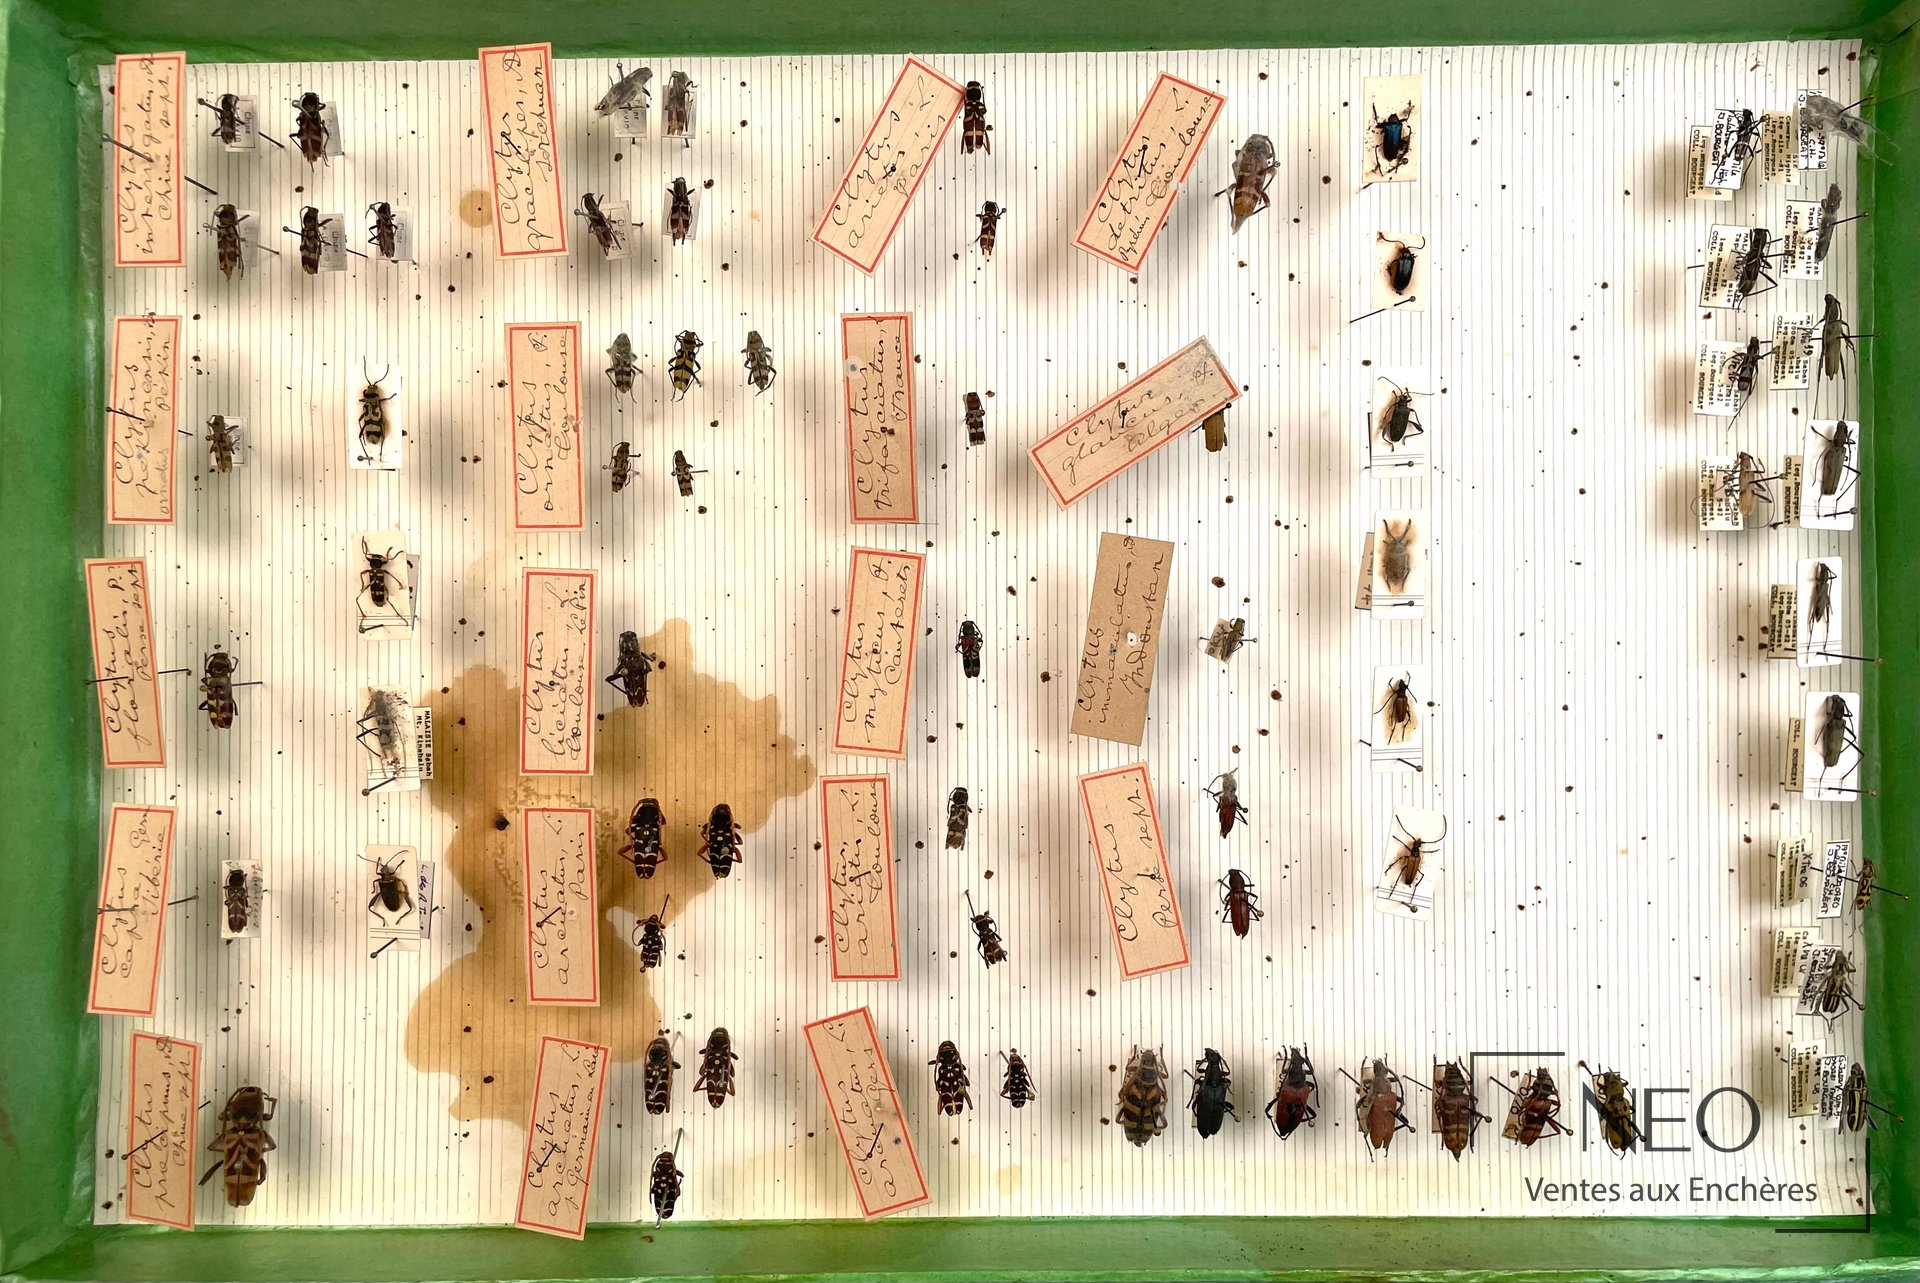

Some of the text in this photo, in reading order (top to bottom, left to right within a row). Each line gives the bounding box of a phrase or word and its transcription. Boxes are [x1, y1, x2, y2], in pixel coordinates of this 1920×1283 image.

[118, 123, 142, 232] Clytus
[156, 147, 172, 220] Chine
[488, 111, 527, 225] Clytus
[824, 105, 901, 227] Clytus
[892, 114, 950, 198] Paris
[1088, 129, 1151, 228] Clytus
[1145, 88, 1218, 208] Toulouse
[1688, 129, 1700, 194] COLL. BOURGEAT
[1702, 230, 1718, 301] COLL. BOURGEAT
[550, 326, 572, 460] Toulouse
[886, 316, 907, 421] France
[1696, 343, 1707, 409] COLL. BOURGEAT
[111, 363, 145, 484] Clytus
[512, 380, 544, 495] Clytus
[847, 366, 883, 495] Clytus
[1783, 486, 1791, 524] BOURGEAT
[1768, 585, 1778, 652] COLL. BOURGEAT
[101, 626, 129, 733] Clytus
[522, 630, 555, 734] Clytus
[839, 620, 872, 723] Clytus
[1790, 748, 1798, 786] BOURGEAT
[567, 832, 588, 900] Paris
[859, 773, 883, 903] Toulouse
[1096, 823, 1140, 943] Clytus
[100, 867, 131, 976] Clytus
[530, 869, 556, 968] Clytus
[1772, 930, 1784, 993] COLL. BOURGEAT
[131, 1083, 165, 1188] Clytus
[837, 1076, 876, 1186] Clytus
